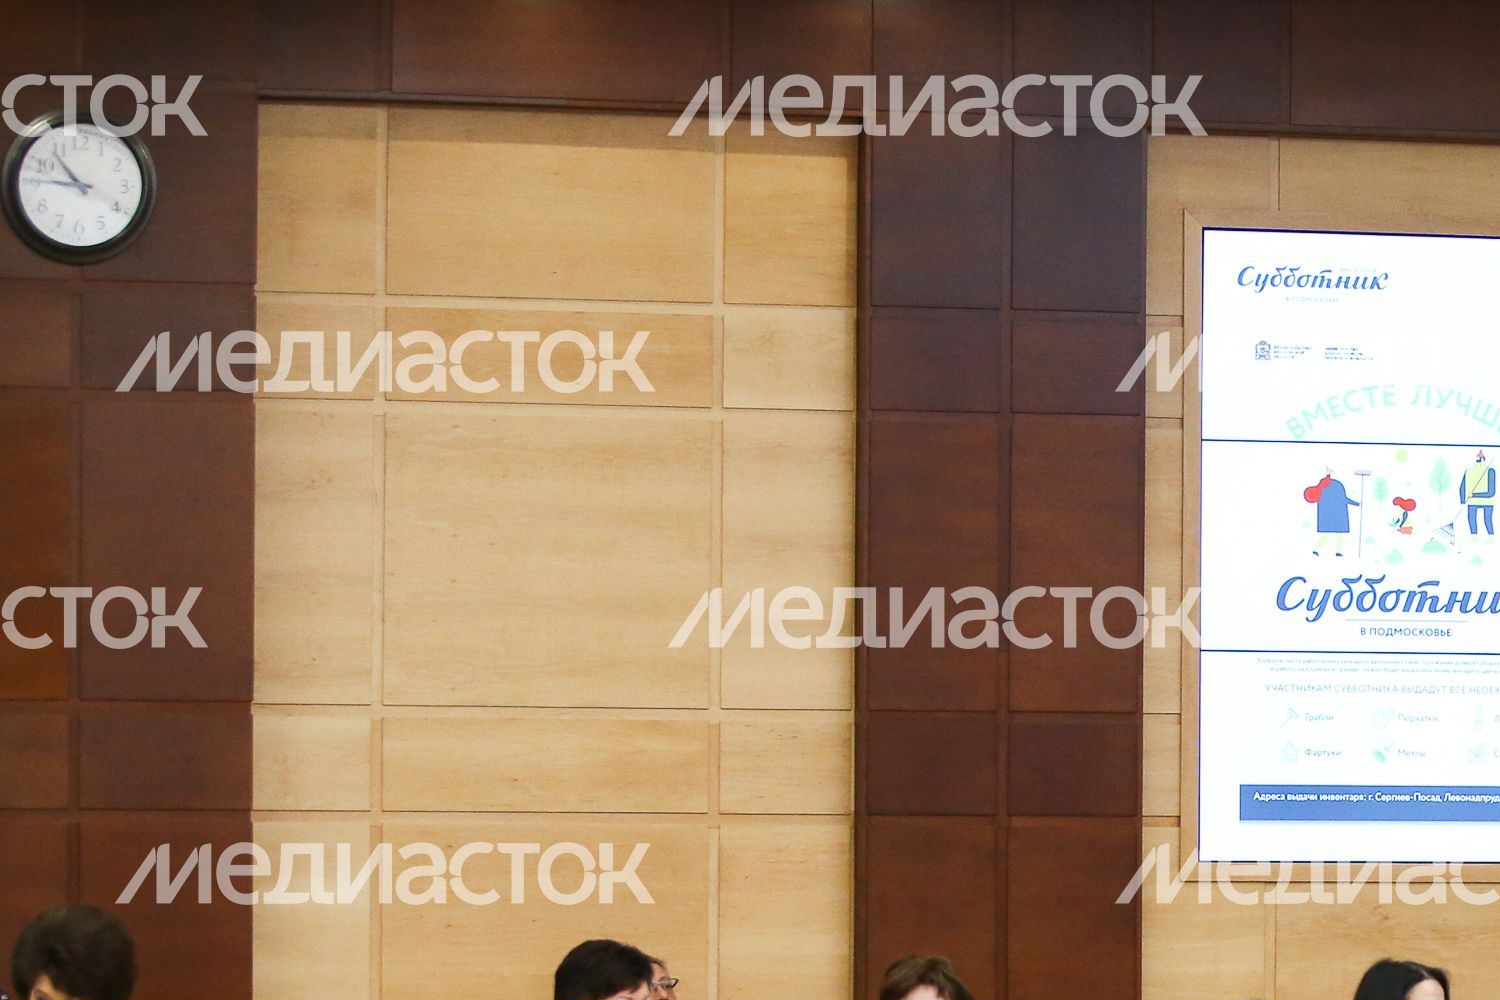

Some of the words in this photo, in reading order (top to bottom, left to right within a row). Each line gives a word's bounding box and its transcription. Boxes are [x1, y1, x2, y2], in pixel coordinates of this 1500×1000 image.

[1236, 265, 1390, 294] Субботник
[1284, 384, 1398, 441] ВМЕСТЕ
[1360, 627, 1367, 637] В
[1369, 627, 1453, 638] ПОДМОСКОВЬЕ
[1253, 791, 1285, 803] Адреса
[1287, 793, 1318, 802] выдачи
[1319, 793, 1367, 803] инвентаря:
